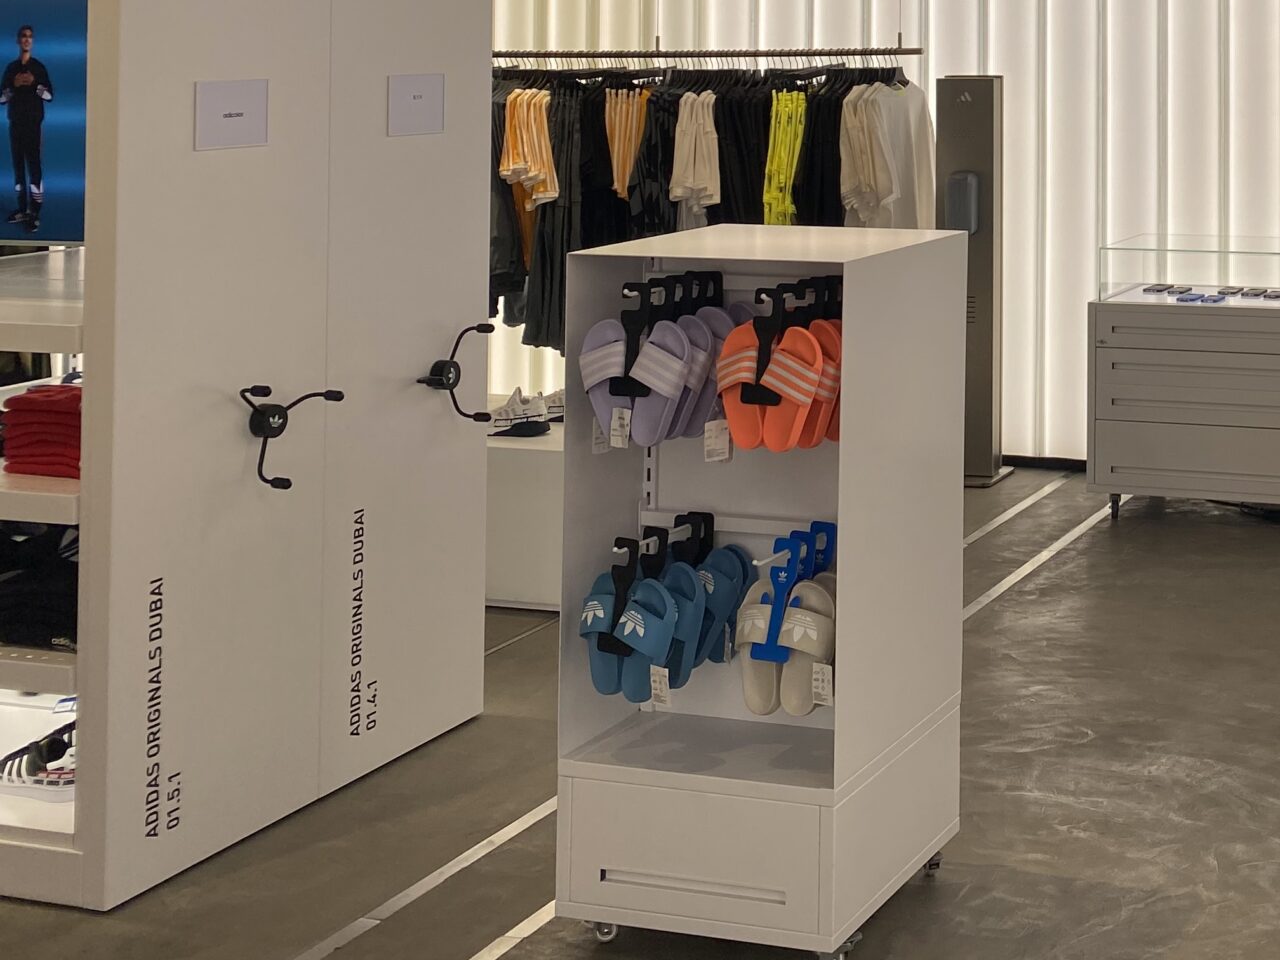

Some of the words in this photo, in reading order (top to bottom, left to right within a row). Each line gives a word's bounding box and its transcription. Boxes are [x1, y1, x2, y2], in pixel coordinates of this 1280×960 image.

[352, 508, 365, 566] DUBAI
[149, 577, 164, 643] DUBAI
[351, 568, 364, 667] ORIGINALS
[147, 645, 162, 760] ORIGINALS
[350, 670, 361, 737] ADIDAS
[366, 679, 378, 732] 01.4.1
[145, 762, 160, 839] ADIDAS
[166, 771, 181, 830] 01.5.1
